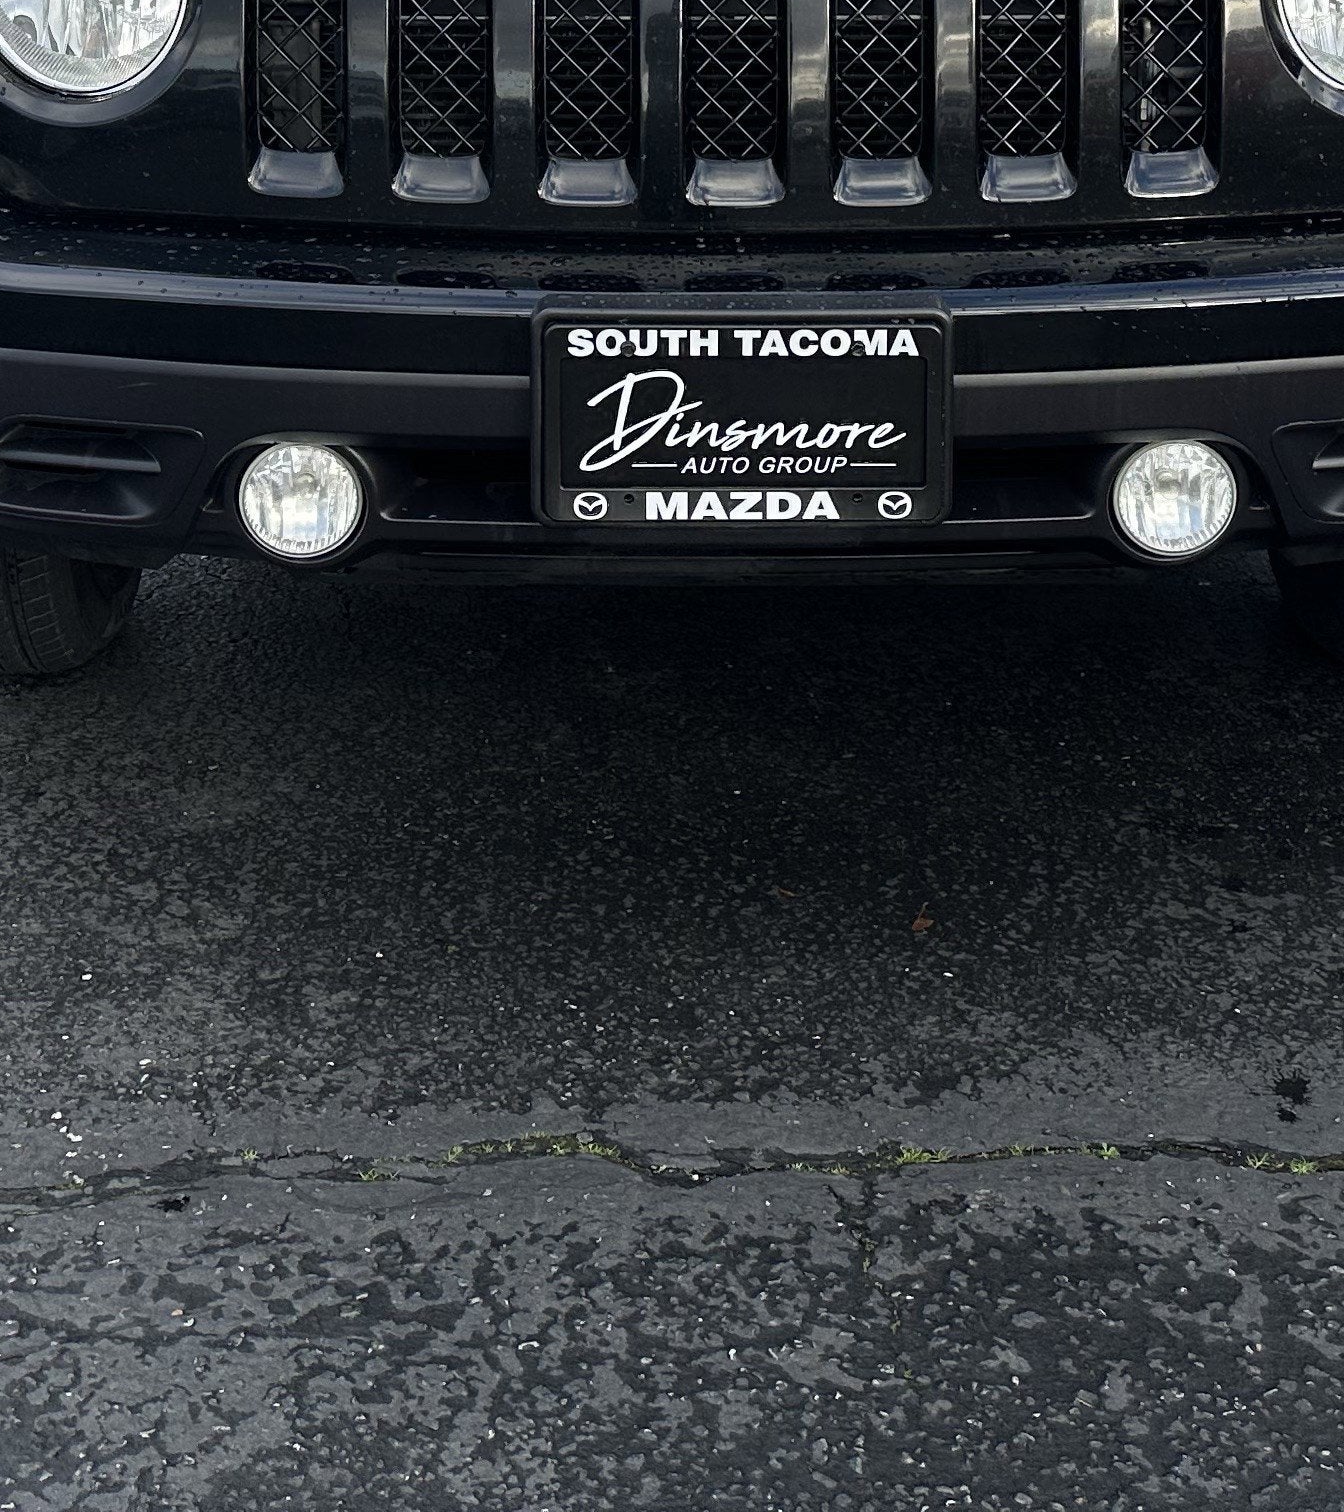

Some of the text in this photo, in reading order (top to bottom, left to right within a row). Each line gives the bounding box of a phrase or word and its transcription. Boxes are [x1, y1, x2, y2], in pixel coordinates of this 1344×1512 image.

[567, 329, 919, 358] SOUTH TACOMA
[579, 369, 907, 472] Dinsmore
[681, 456, 848, 474] AUTO GROUP
[645, 491, 840, 521] MAZDA
